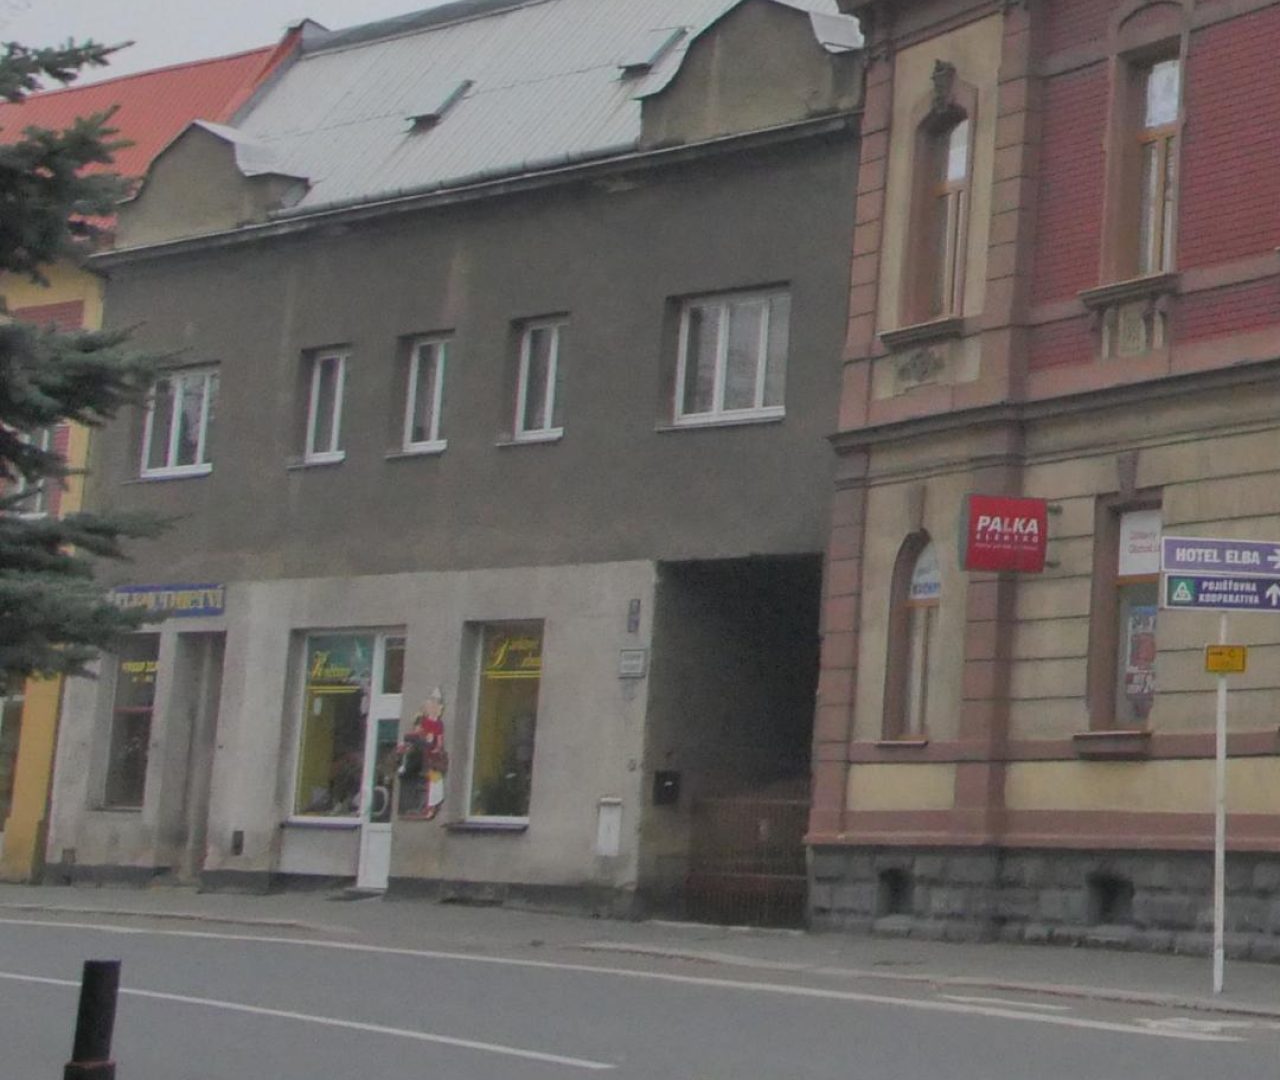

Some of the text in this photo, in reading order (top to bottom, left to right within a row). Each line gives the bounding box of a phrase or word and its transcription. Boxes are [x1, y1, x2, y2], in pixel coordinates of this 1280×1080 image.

[976, 515, 1039, 534] PALKA
[1175, 547, 1260, 565] HOTEL ELBA
